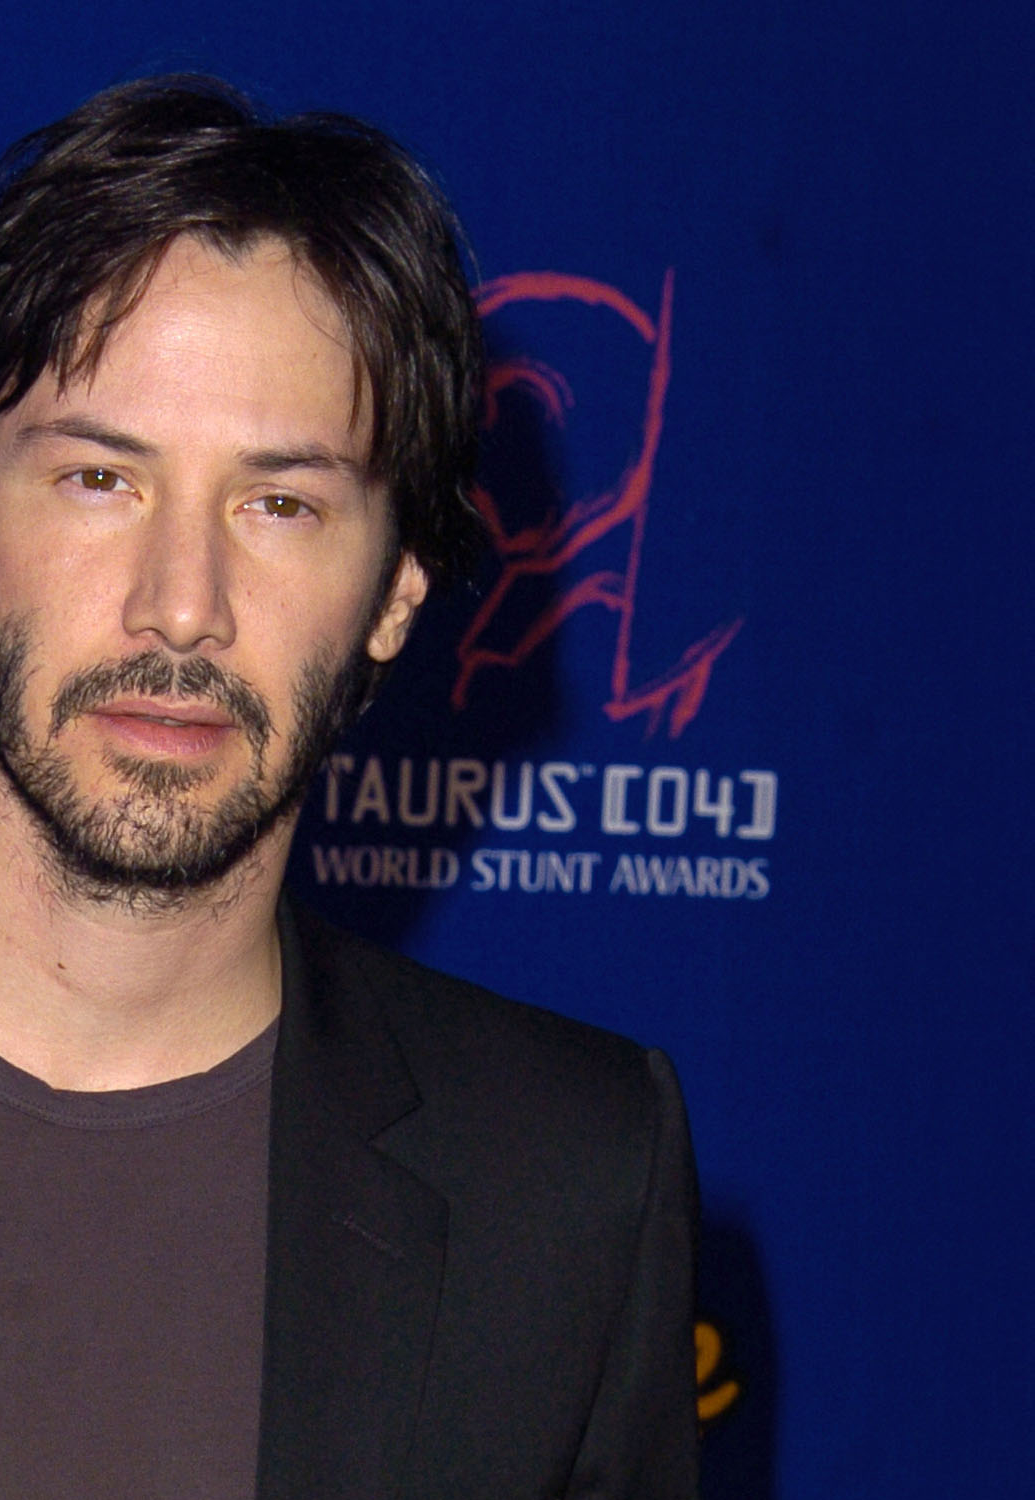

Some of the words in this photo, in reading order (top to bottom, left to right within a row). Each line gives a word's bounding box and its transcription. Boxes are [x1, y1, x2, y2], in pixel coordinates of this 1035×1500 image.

[312, 845, 461, 889] WORLD
[470, 849, 602, 894] STUNT
[609, 853, 770, 900] AWARDS
